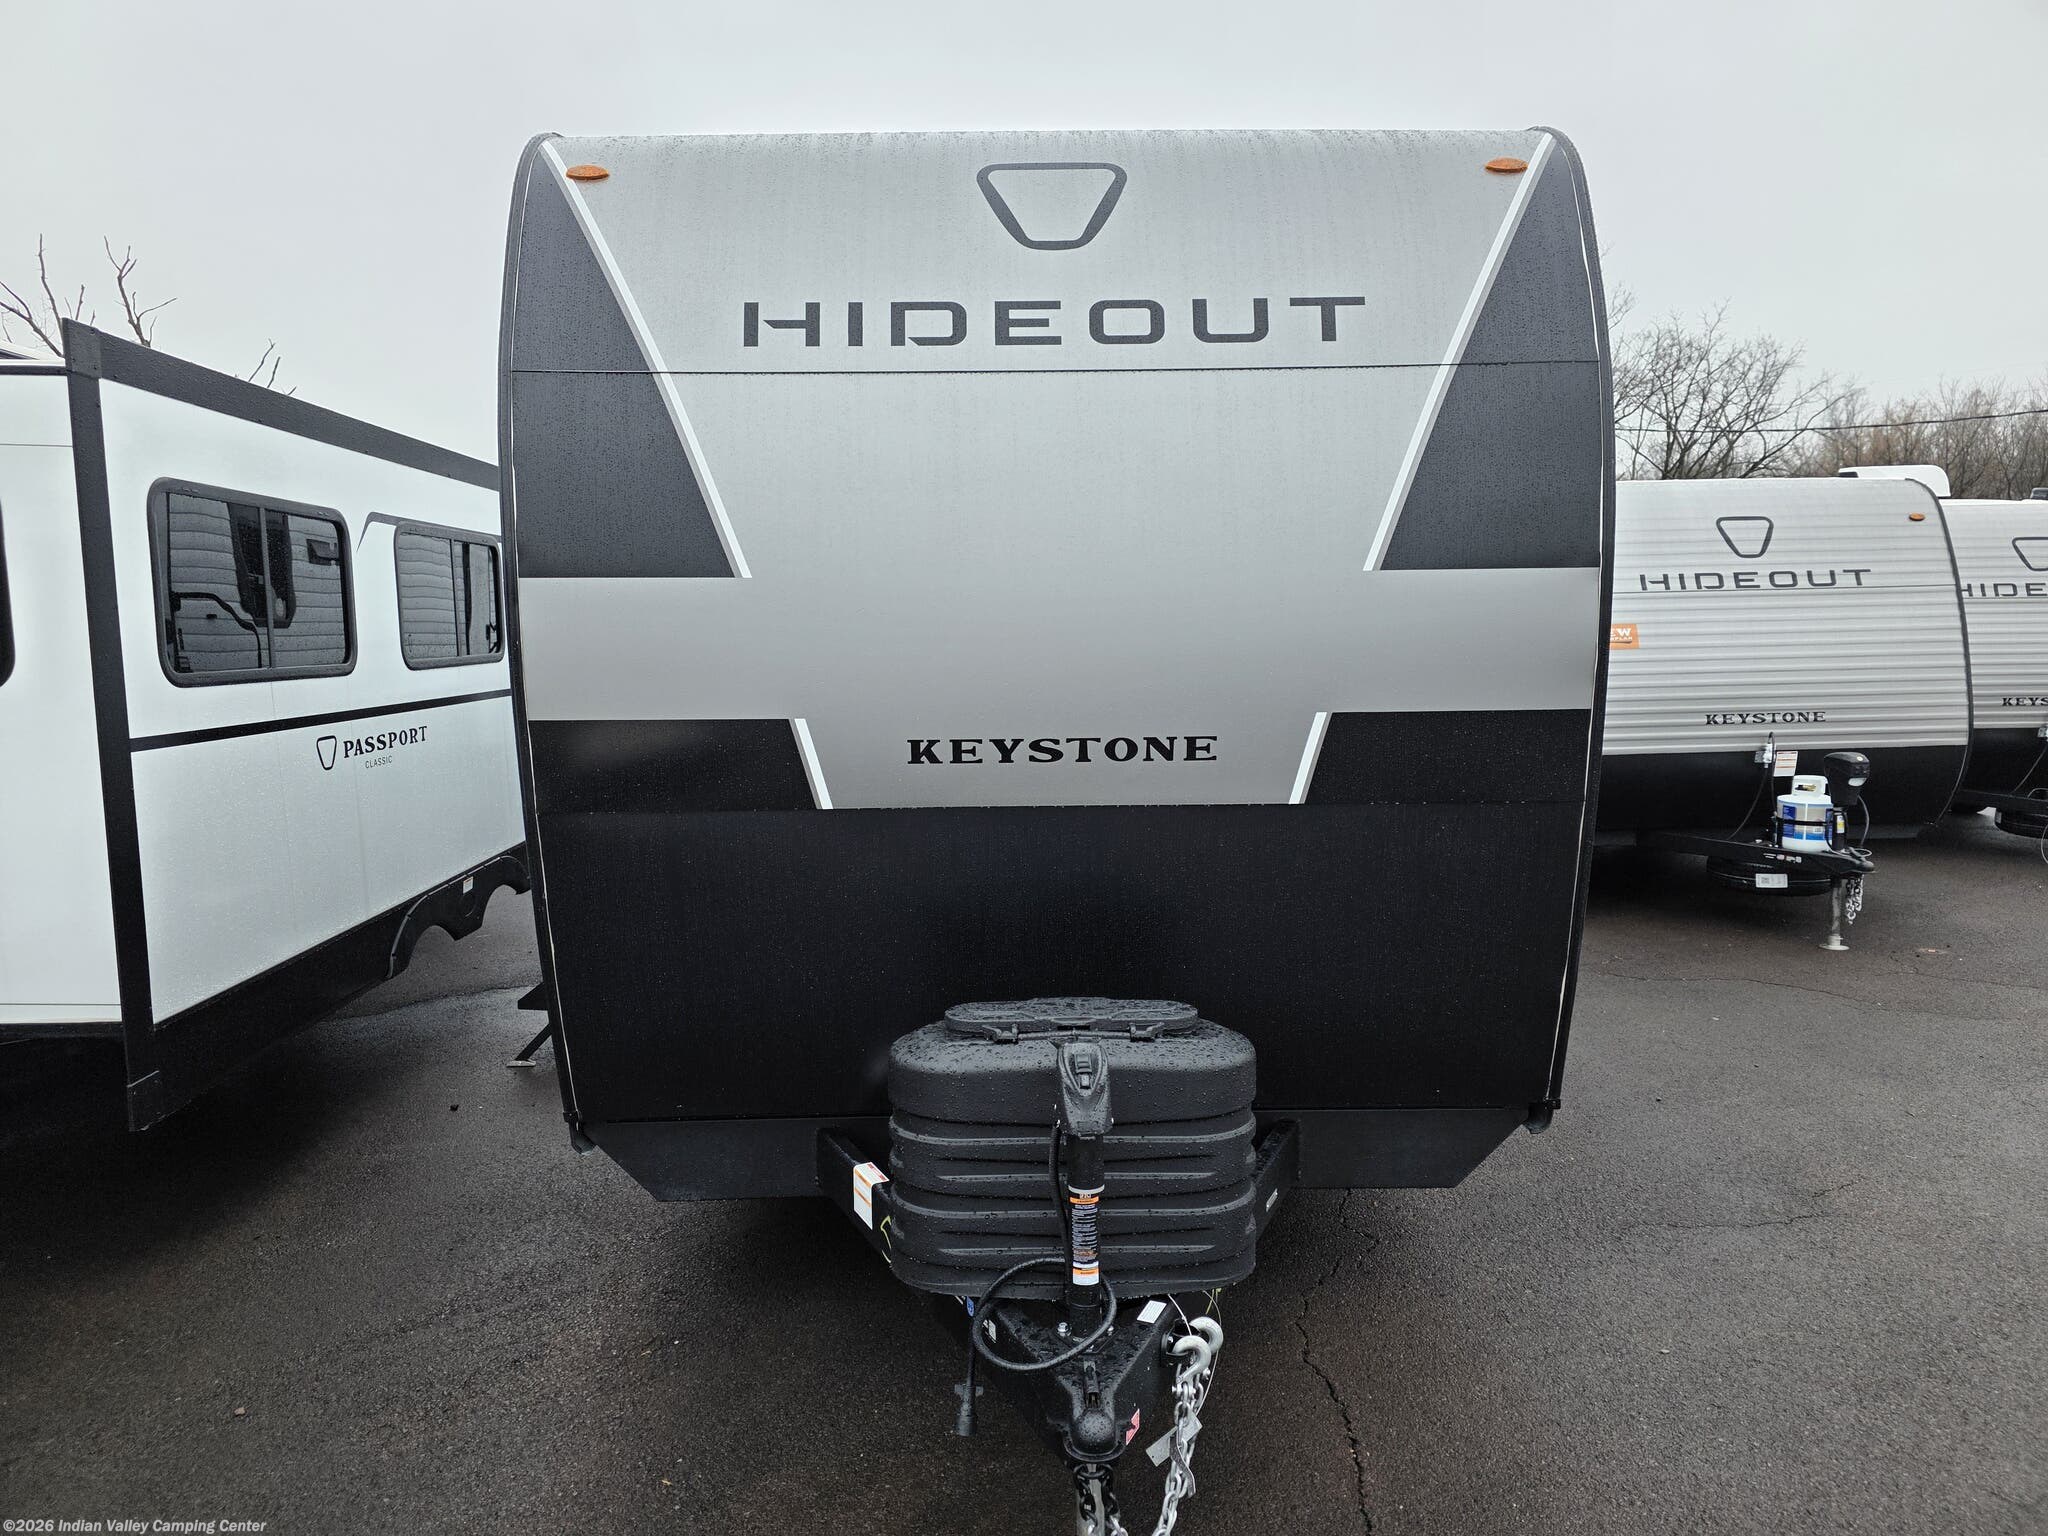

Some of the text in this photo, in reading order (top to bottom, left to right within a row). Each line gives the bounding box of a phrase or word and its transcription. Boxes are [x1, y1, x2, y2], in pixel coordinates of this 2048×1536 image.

[743, 296, 1366, 347] HIDEOUT
[1639, 569, 1872, 591] HIDEOUT
[1705, 711, 1827, 725] KEYSTONE
[343, 725, 428, 759] PASSPORT
[906, 735, 1218, 765] KEYSTONE
[364, 755, 394, 769] CLASSIC
